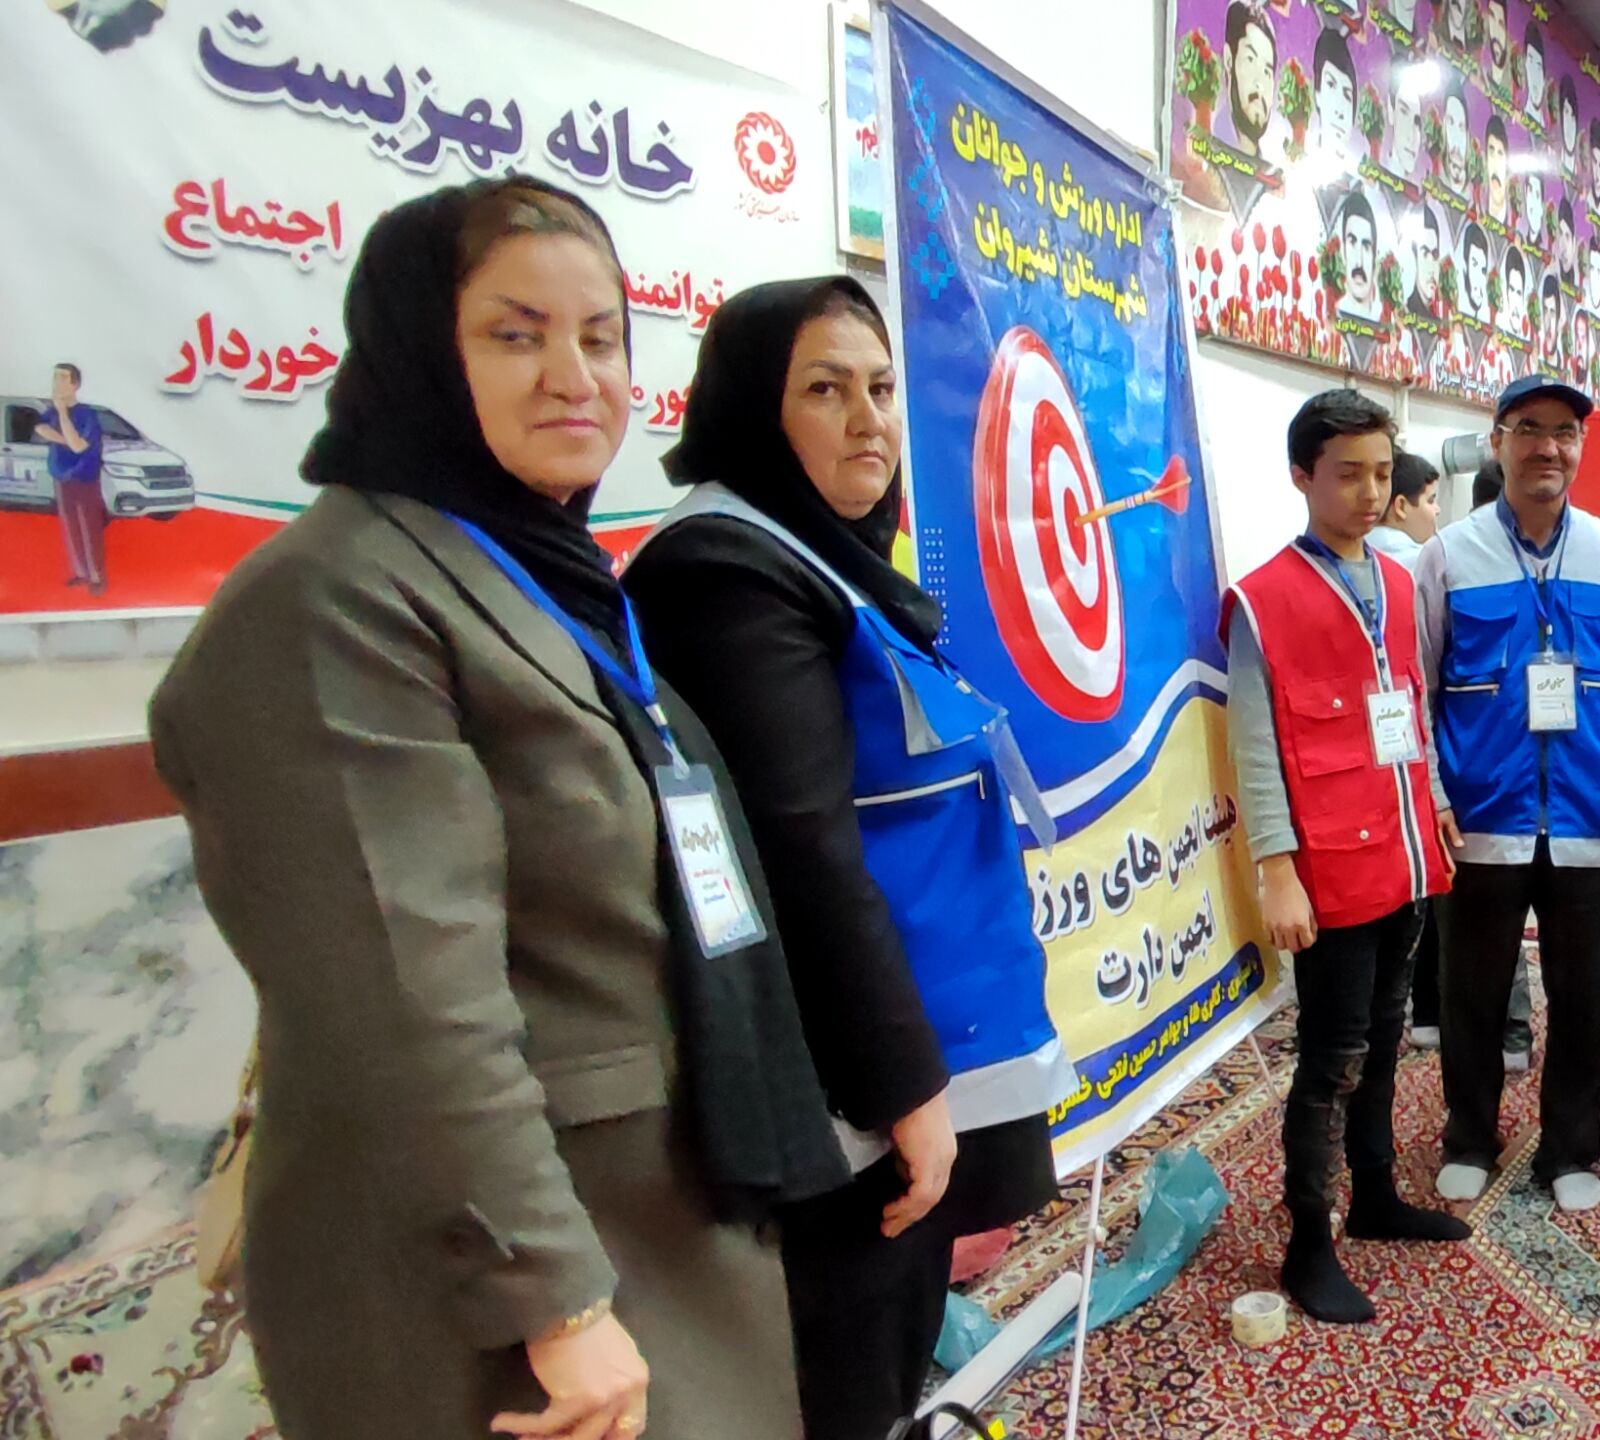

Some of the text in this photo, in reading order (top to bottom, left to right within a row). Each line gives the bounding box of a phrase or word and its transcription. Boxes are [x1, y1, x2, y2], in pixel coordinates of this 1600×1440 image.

[199, 9, 694, 194] خانه بهزیست
[951, 103, 1028, 195] جوانان
[1033, 162, 1045, 206] و
[165, 178, 342, 263] اجتماع
[1049, 161, 1103, 239] ورزش
[1106, 200, 1142, 249] اداره
[974, 202, 1148, 323] شهرستان شیروان
[1101, 832, 1162, 910] های
[1168, 803, 1203, 885] انجمن
[1029, 870, 1091, 936] ورز
[1171, 889, 1217, 978] انجمن
[1097, 928, 1164, 1004] دارت
[1096, 1052, 1128, 1100] فتحی
[1129, 1038, 1157, 1078] حسین
